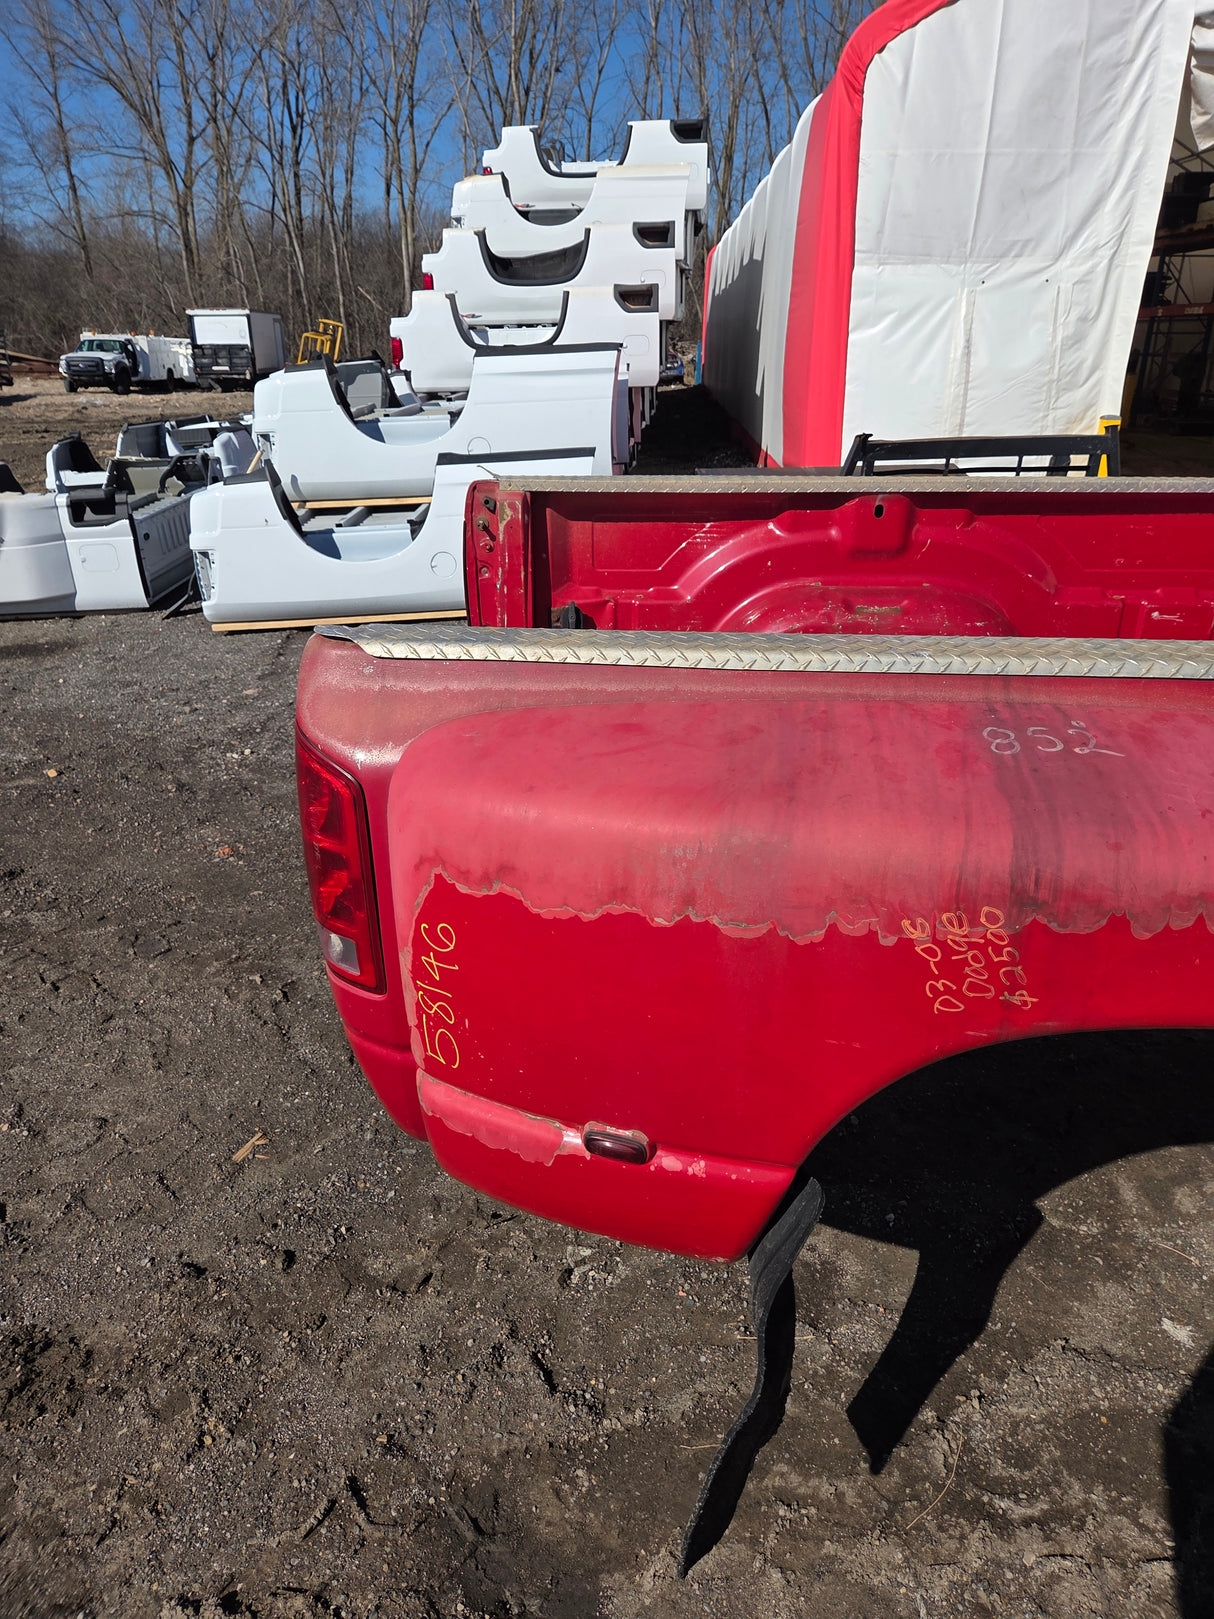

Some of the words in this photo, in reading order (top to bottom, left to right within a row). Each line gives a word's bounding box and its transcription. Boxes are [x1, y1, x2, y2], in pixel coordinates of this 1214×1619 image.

[982, 724, 1126, 757] 852
[416, 923, 460, 1069] 58146
[979, 906, 1039, 1010] $2500
